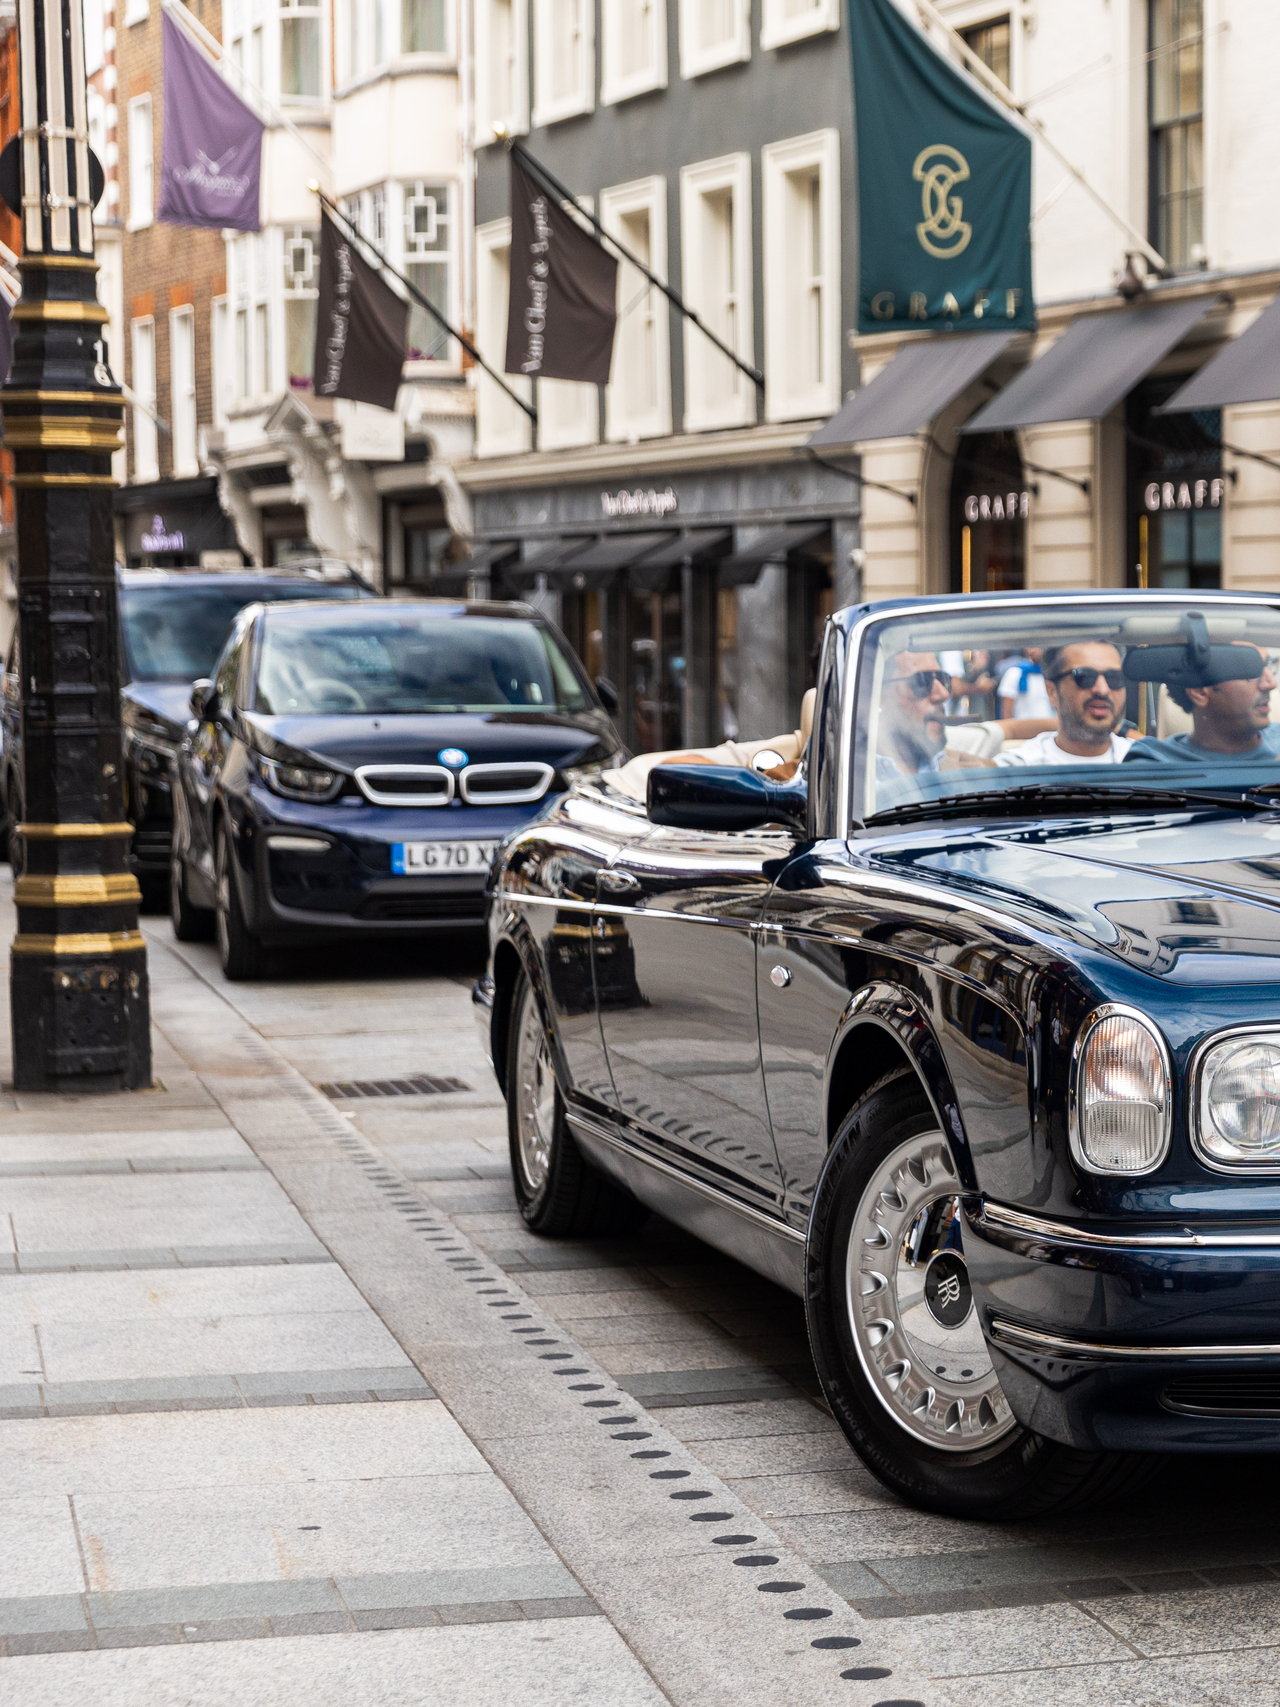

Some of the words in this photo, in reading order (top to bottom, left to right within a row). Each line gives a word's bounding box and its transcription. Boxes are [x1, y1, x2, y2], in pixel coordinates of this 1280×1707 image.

[871, 287, 1022, 321] GRAFF
[1144, 478, 1225, 512] GRAFF
[407, 845, 469, 868] LG70
